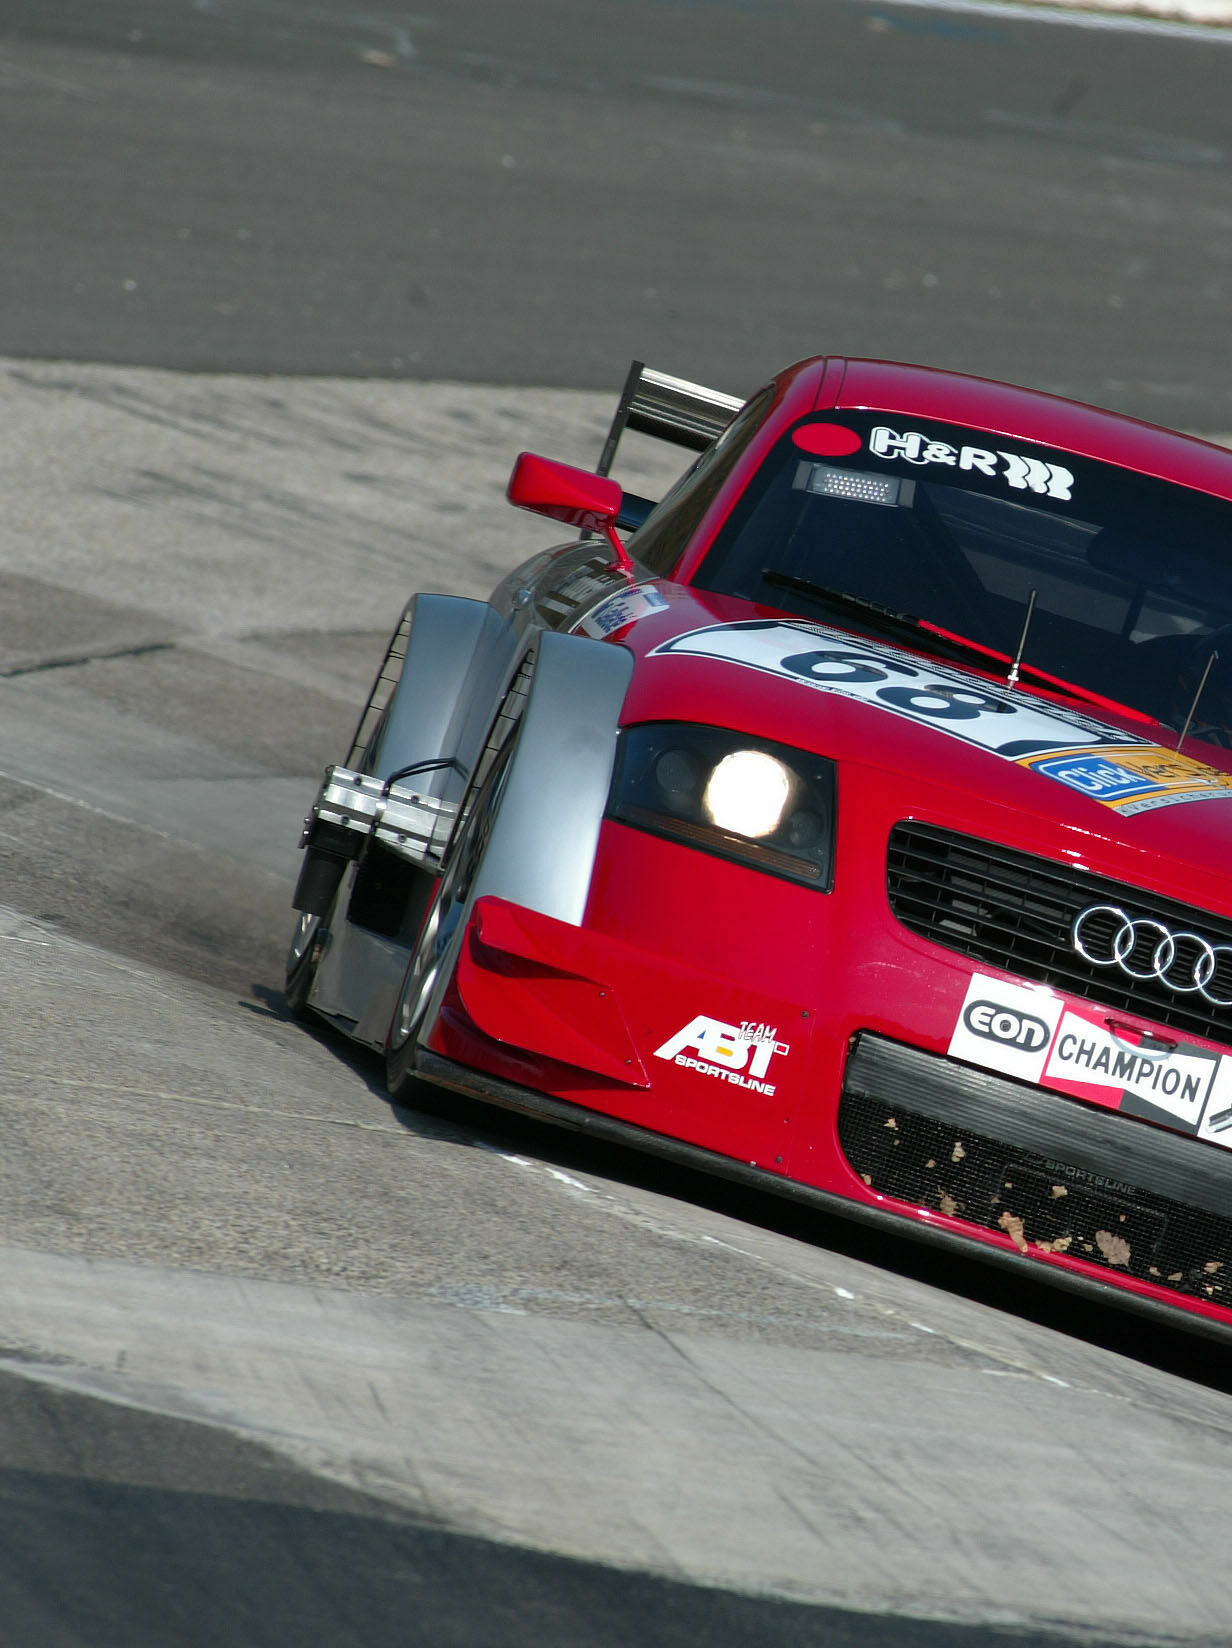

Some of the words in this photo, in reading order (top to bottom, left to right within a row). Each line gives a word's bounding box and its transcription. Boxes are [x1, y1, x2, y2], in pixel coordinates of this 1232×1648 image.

[780, 650, 1018, 720] 68
[653, 1014, 790, 1079] ABT
[739, 1020, 778, 1043] TEAM
[674, 1054, 776, 1097] SPORTSLINE
[1057, 1033, 1202, 1103] CHAMPION
